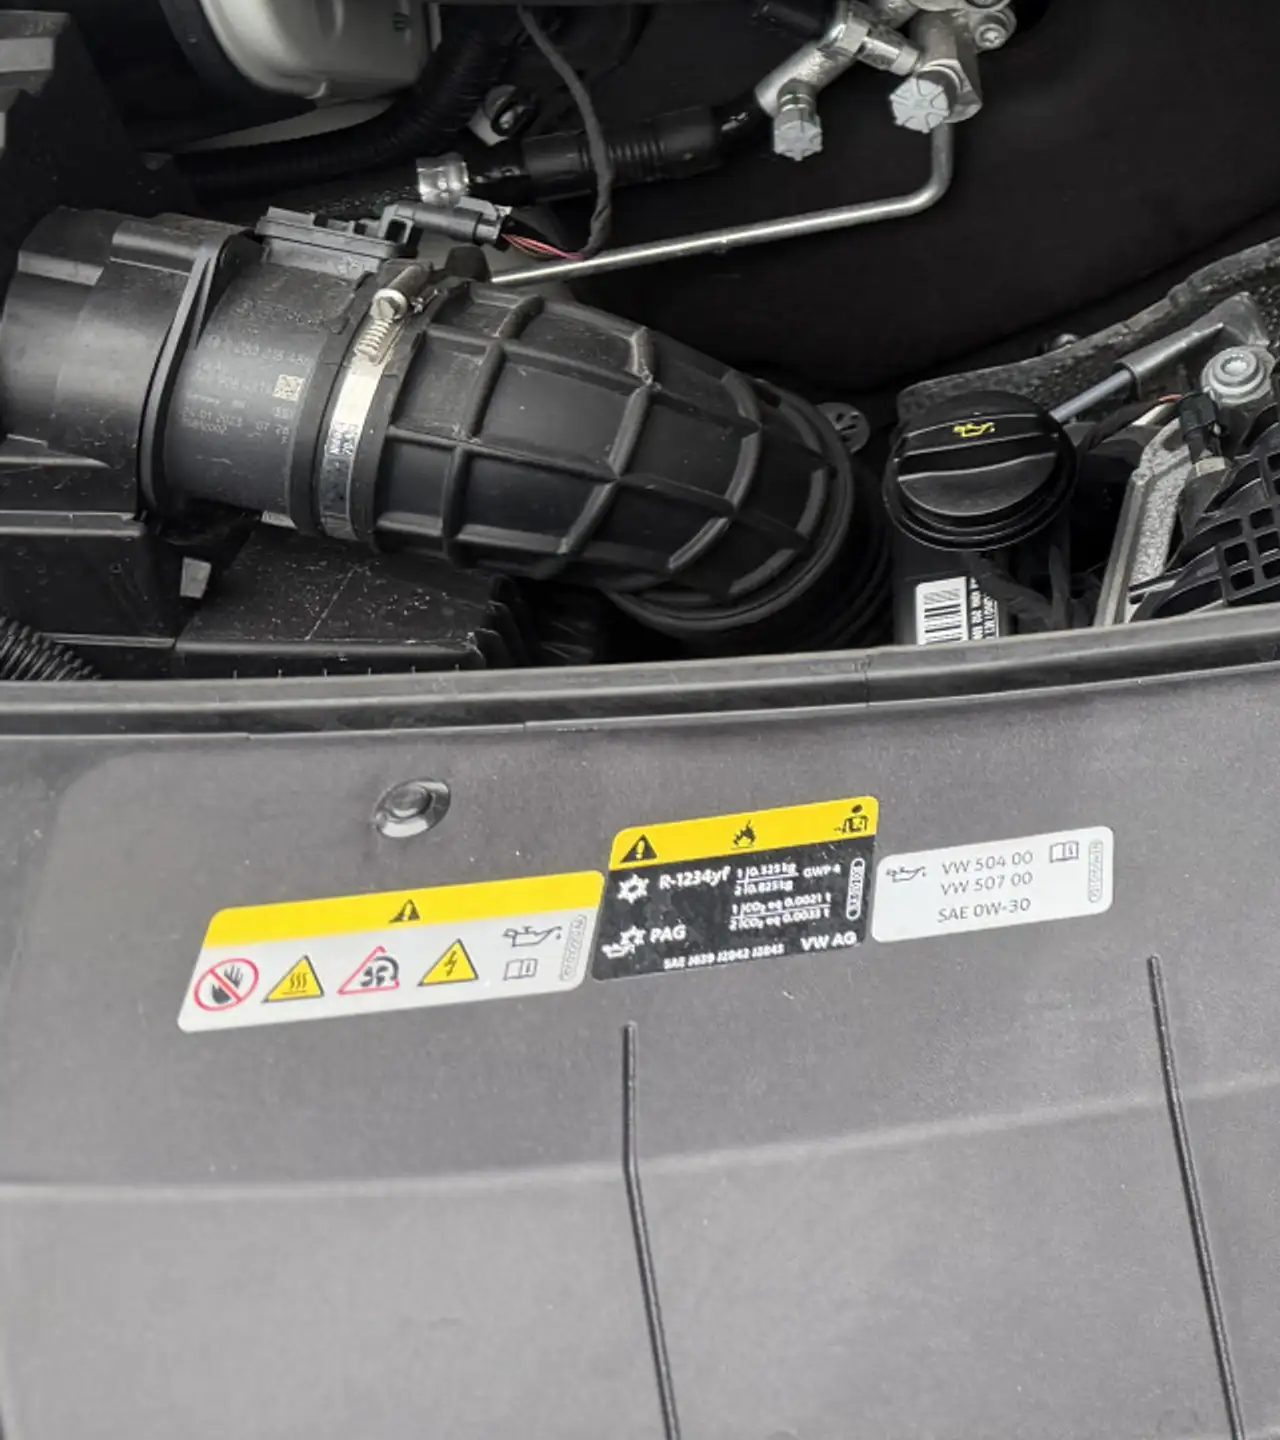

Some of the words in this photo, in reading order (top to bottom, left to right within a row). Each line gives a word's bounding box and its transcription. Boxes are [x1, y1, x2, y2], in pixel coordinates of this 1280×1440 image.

[942, 858, 971, 876] VW
[974, 855, 1006, 872] 504
[1011, 849, 1034, 866] 00
[658, 865, 731, 891] R-1234yf
[941, 878, 970, 896] VW
[973, 874, 1006, 892] 507
[1010, 870, 1034, 887] 00
[937, 905, 970, 924] SAE
[973, 897, 1032, 918] 0W-30
[649, 924, 687, 944] PAG
[800, 934, 830, 952] VW
[831, 931, 857, 948] AG
[663, 955, 686, 971] SAE
